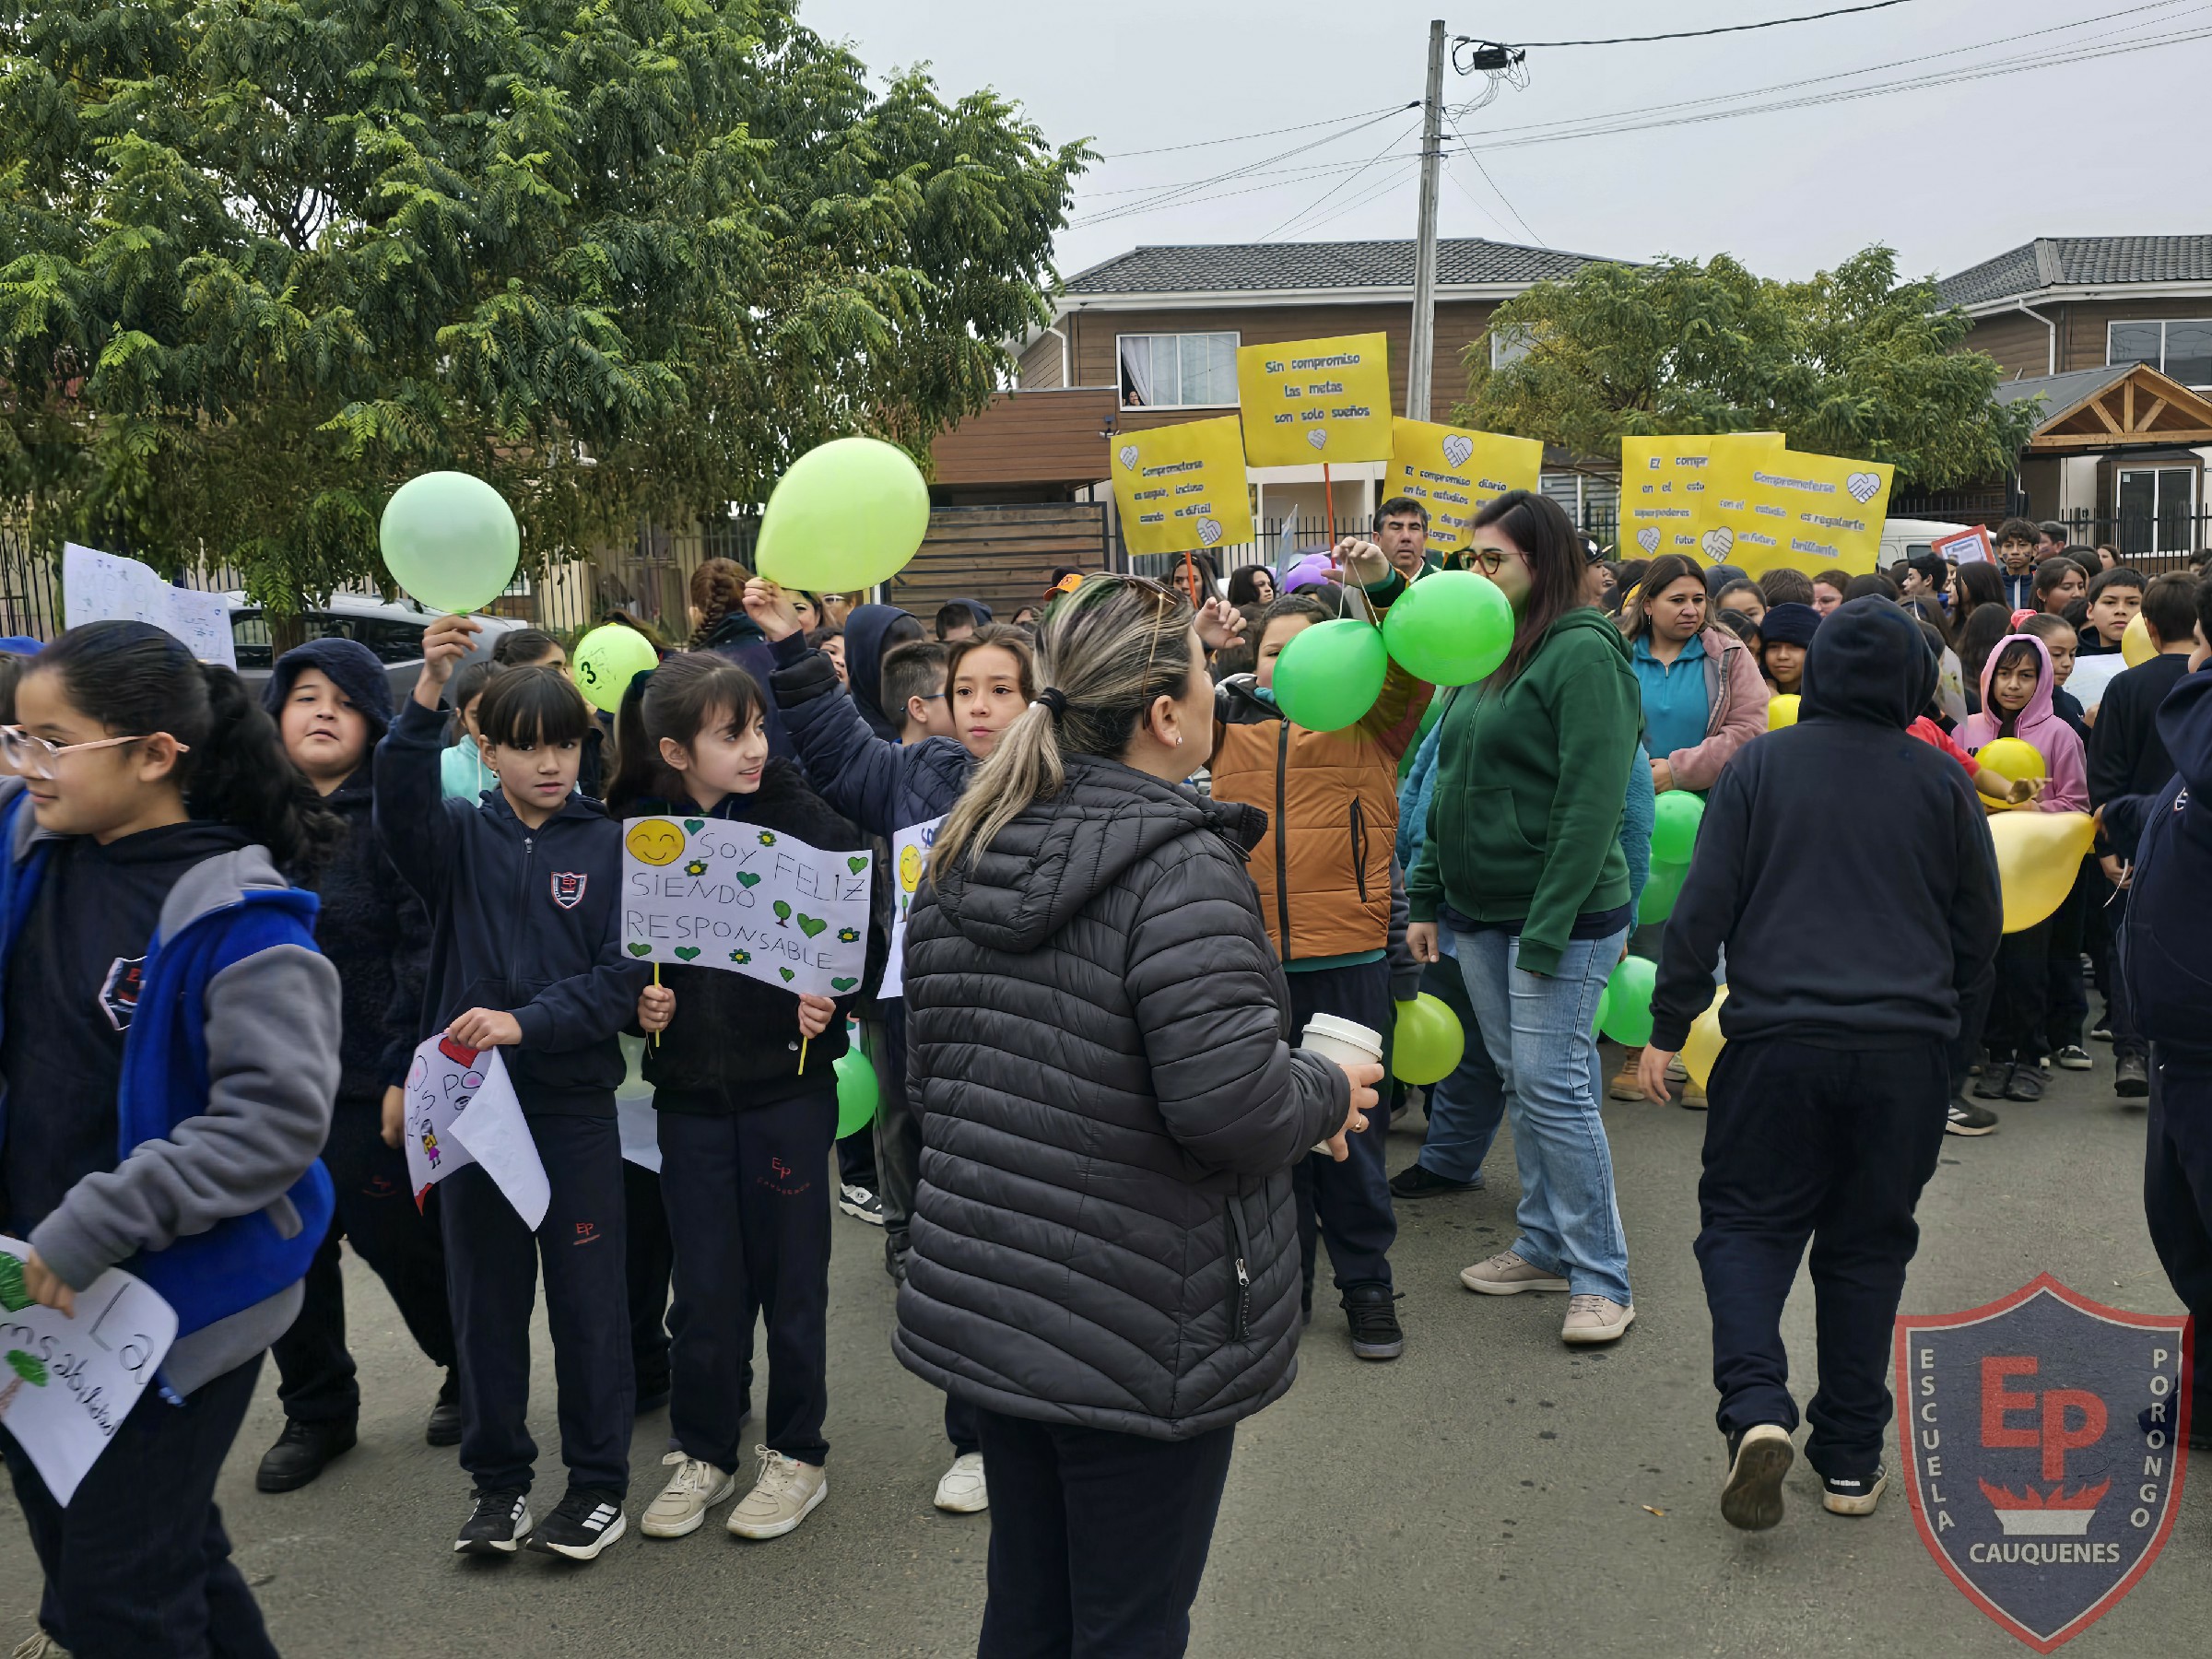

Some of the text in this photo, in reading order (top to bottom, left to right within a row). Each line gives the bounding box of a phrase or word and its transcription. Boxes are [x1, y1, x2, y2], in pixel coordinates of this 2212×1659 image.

[1265, 352, 1360, 373] Sin compromiso
[1284, 380, 1343, 397] las metas
[1274, 405, 1371, 423] son solo sueños
[1649, 456, 1708, 469] El compr
[1405, 465, 1508, 492] El compromiso diario
[1662, 480, 1672, 492] el
[1686, 481, 1705, 491] estu
[1175, 482, 1205, 495] incluso
[1432, 489, 1469, 506] estudios
[1675, 535, 1696, 545] futur
[698, 832, 869, 902] SOY FELIZ
[631, 871, 756, 909] SIENDO
[626, 909, 833, 970] RESPONSABLE
[575, 1222, 594, 1236] EP
